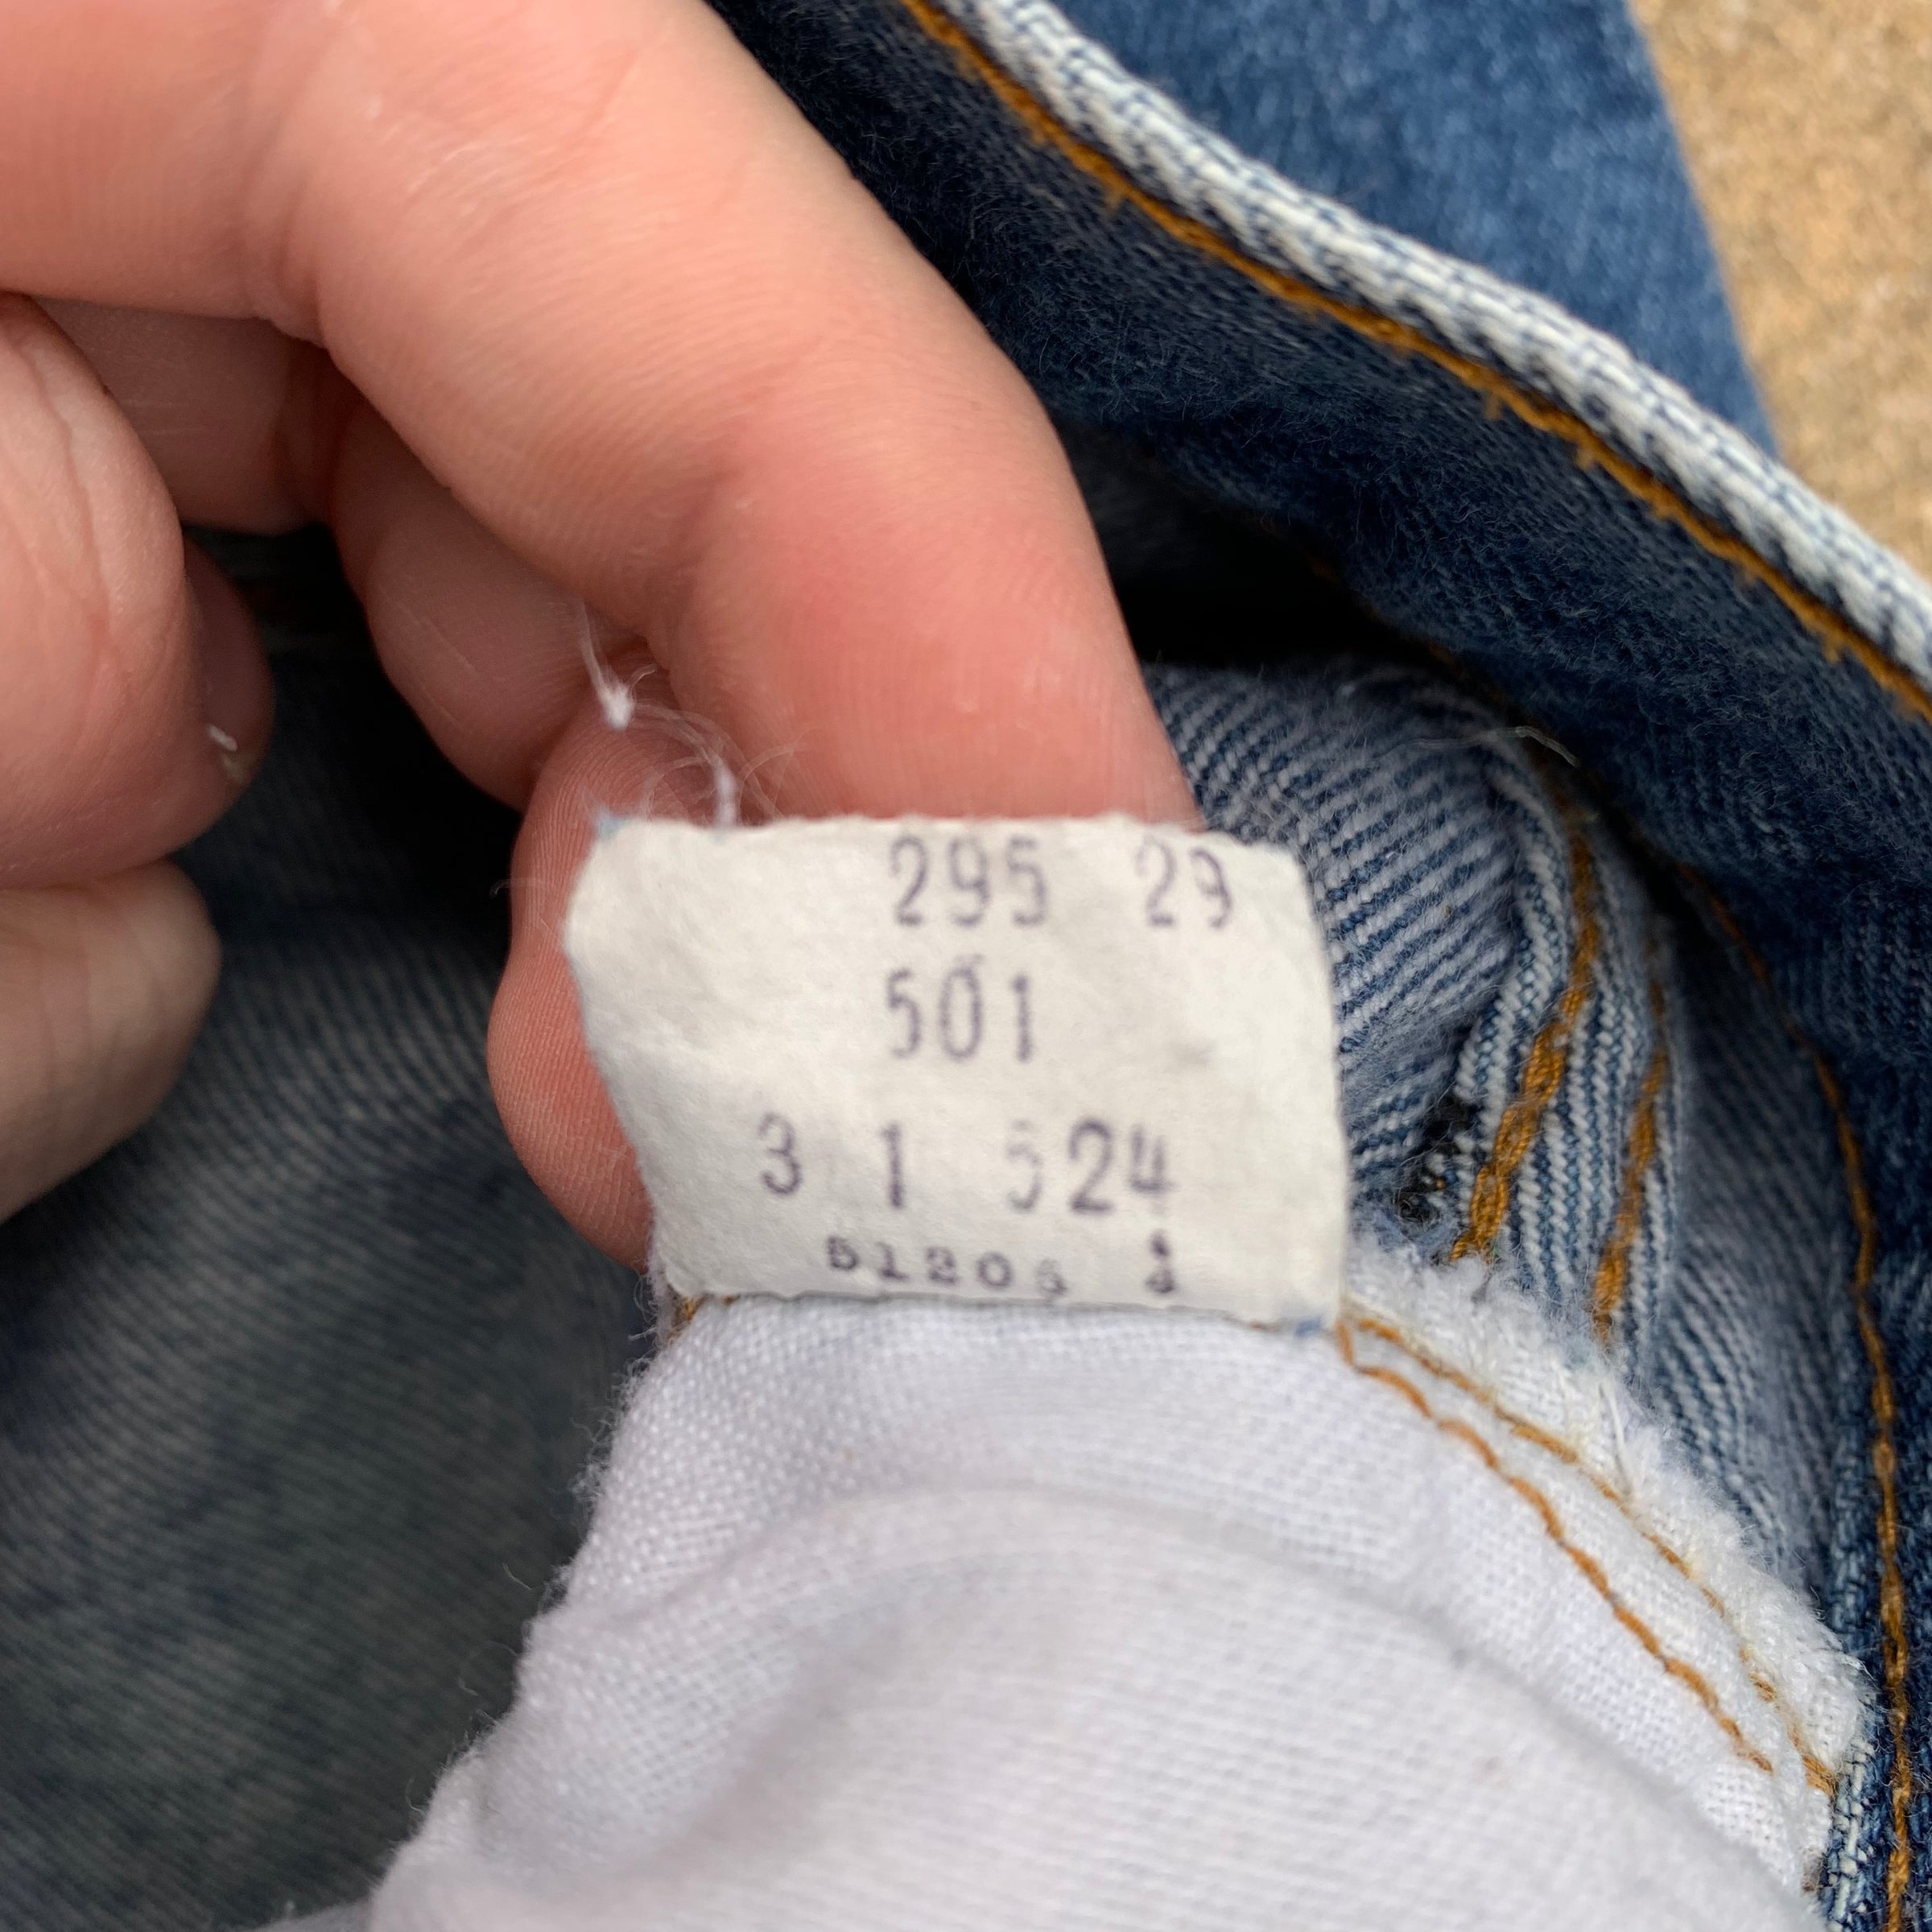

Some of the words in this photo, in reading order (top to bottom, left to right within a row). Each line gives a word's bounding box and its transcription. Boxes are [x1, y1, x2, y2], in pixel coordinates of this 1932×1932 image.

[888, 836, 1048, 928] 295
[1136, 840, 1233, 928] 29
[886, 960, 1034, 1062] 501
[757, 1113, 802, 1197] 3
[881, 1125, 906, 1211] 1
